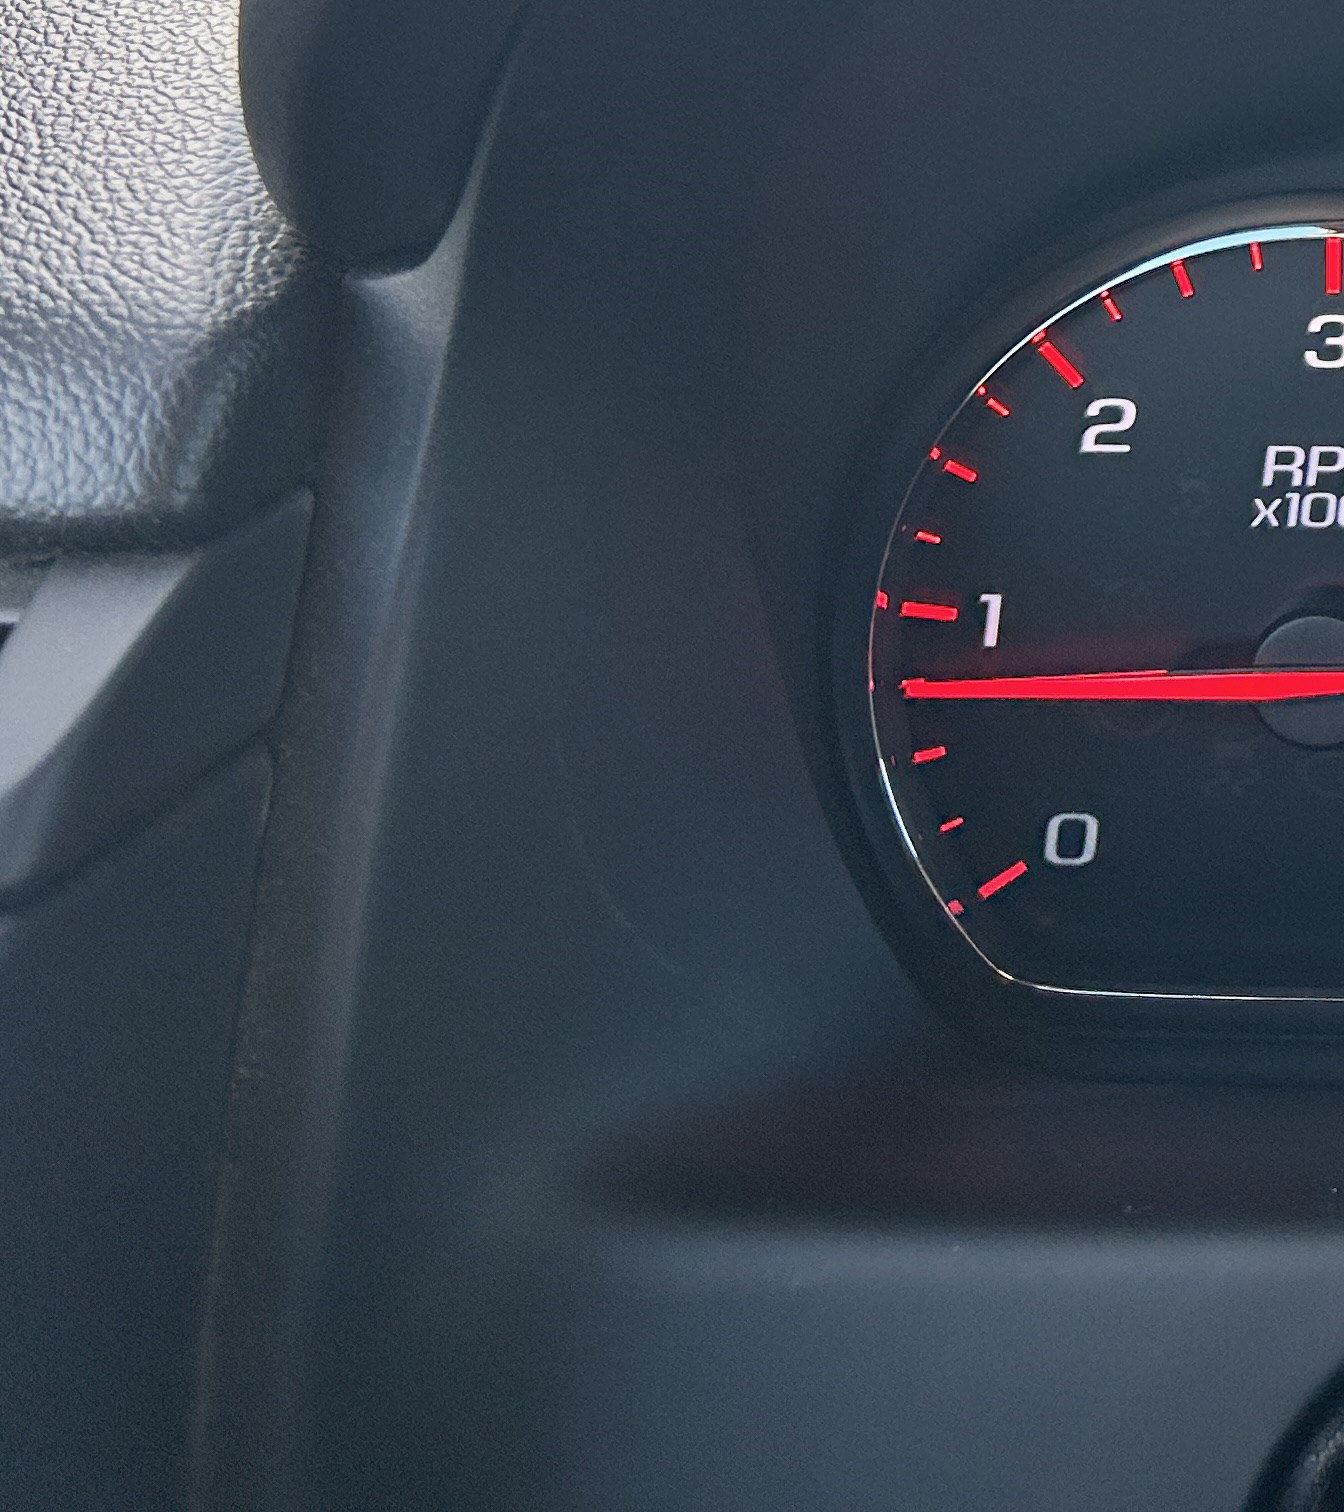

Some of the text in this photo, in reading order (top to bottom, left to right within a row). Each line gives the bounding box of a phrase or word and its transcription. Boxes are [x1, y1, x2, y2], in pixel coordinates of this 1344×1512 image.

[1080, 397, 1137, 453] 2
[979, 593, 1003, 648] 1
[1044, 812, 1099, 867] 0
